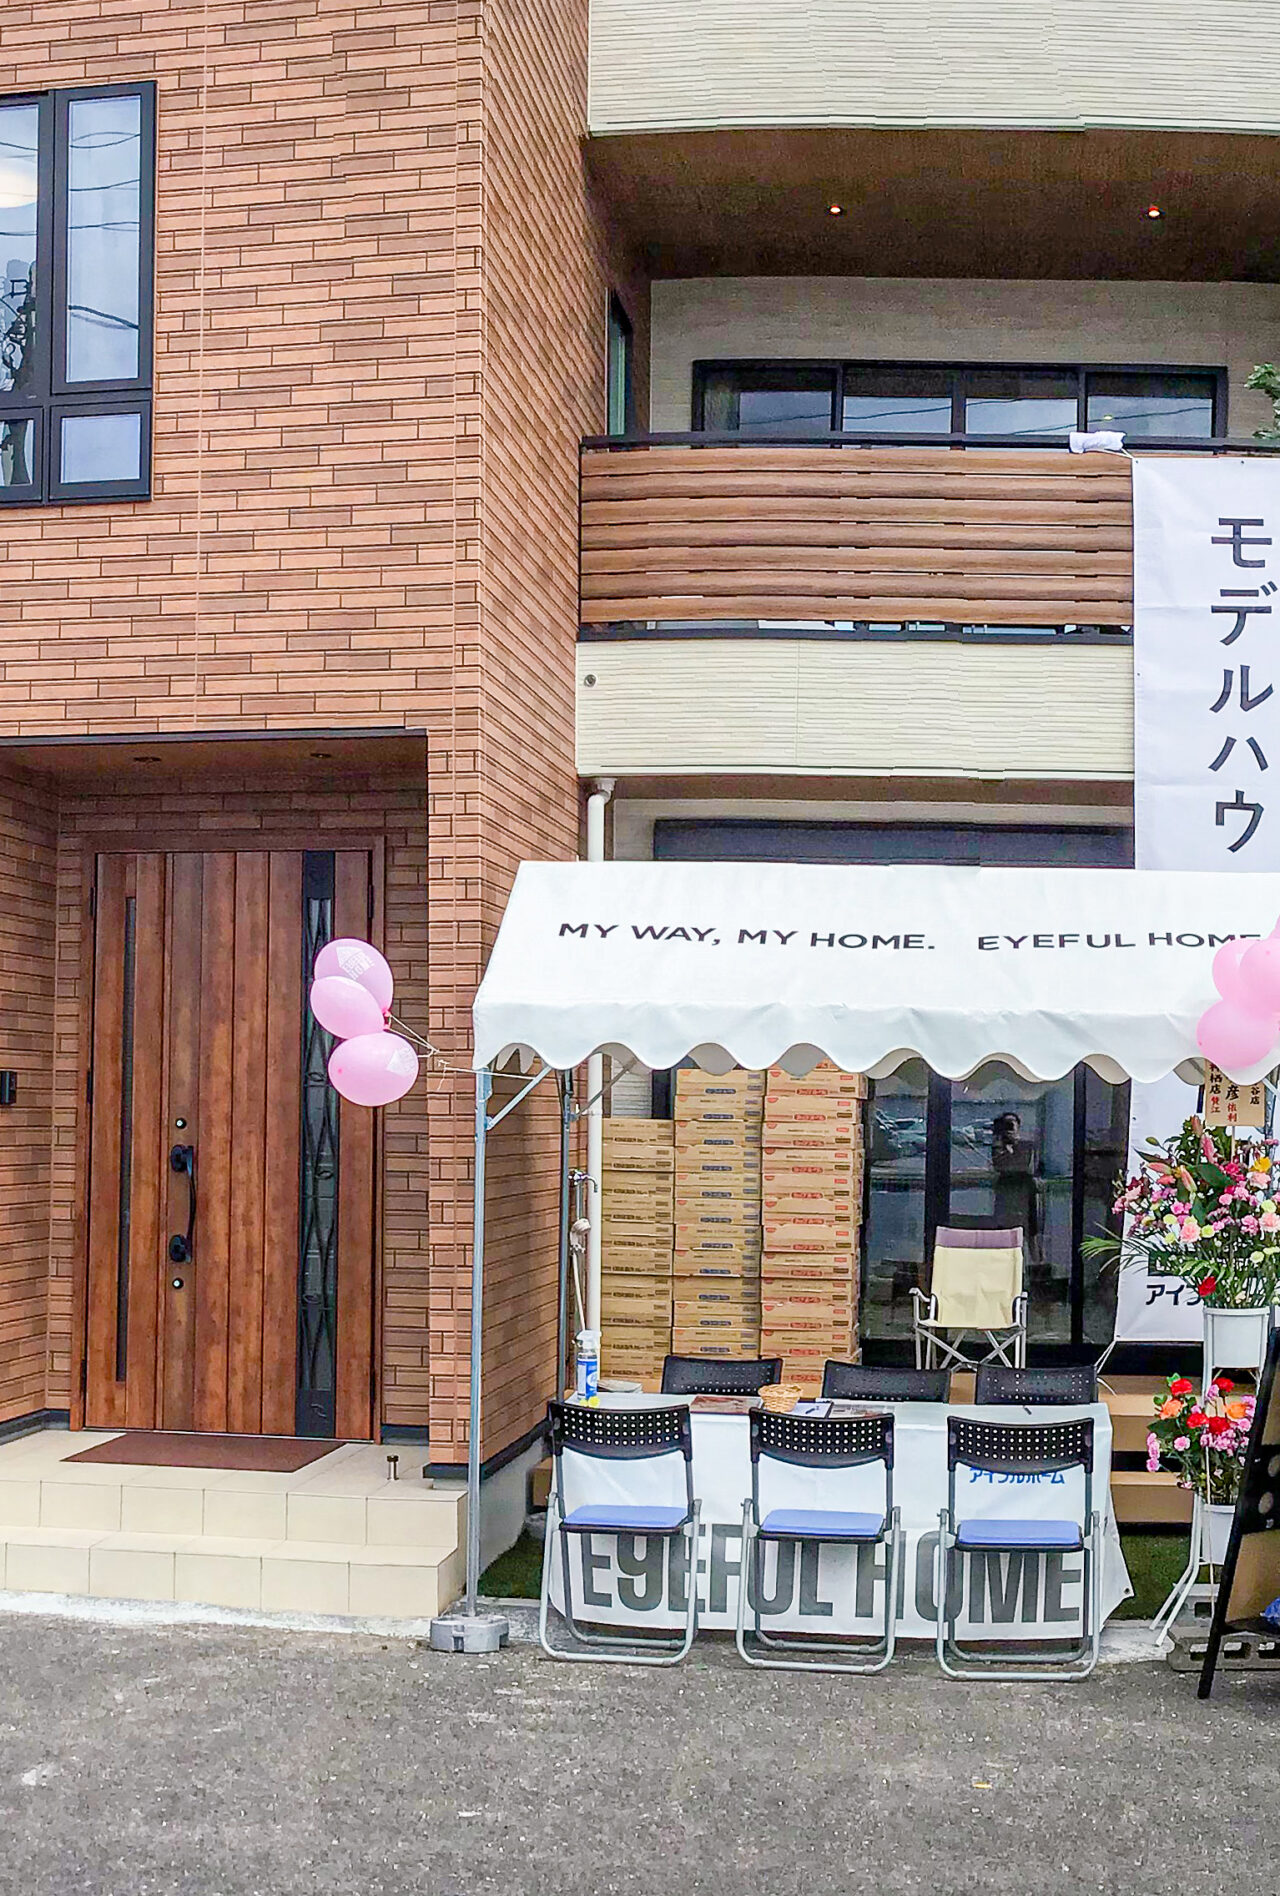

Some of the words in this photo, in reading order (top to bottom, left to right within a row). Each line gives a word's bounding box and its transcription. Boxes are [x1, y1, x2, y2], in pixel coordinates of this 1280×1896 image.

[1208, 516, 1279, 854] モデルハウ
[558, 922, 620, 939] MY
[631, 924, 721, 946] WAY,
[737, 929, 799, 945] MY
[810, 932, 935, 950] HOME.
[978, 933, 1136, 950] EYEFUL
